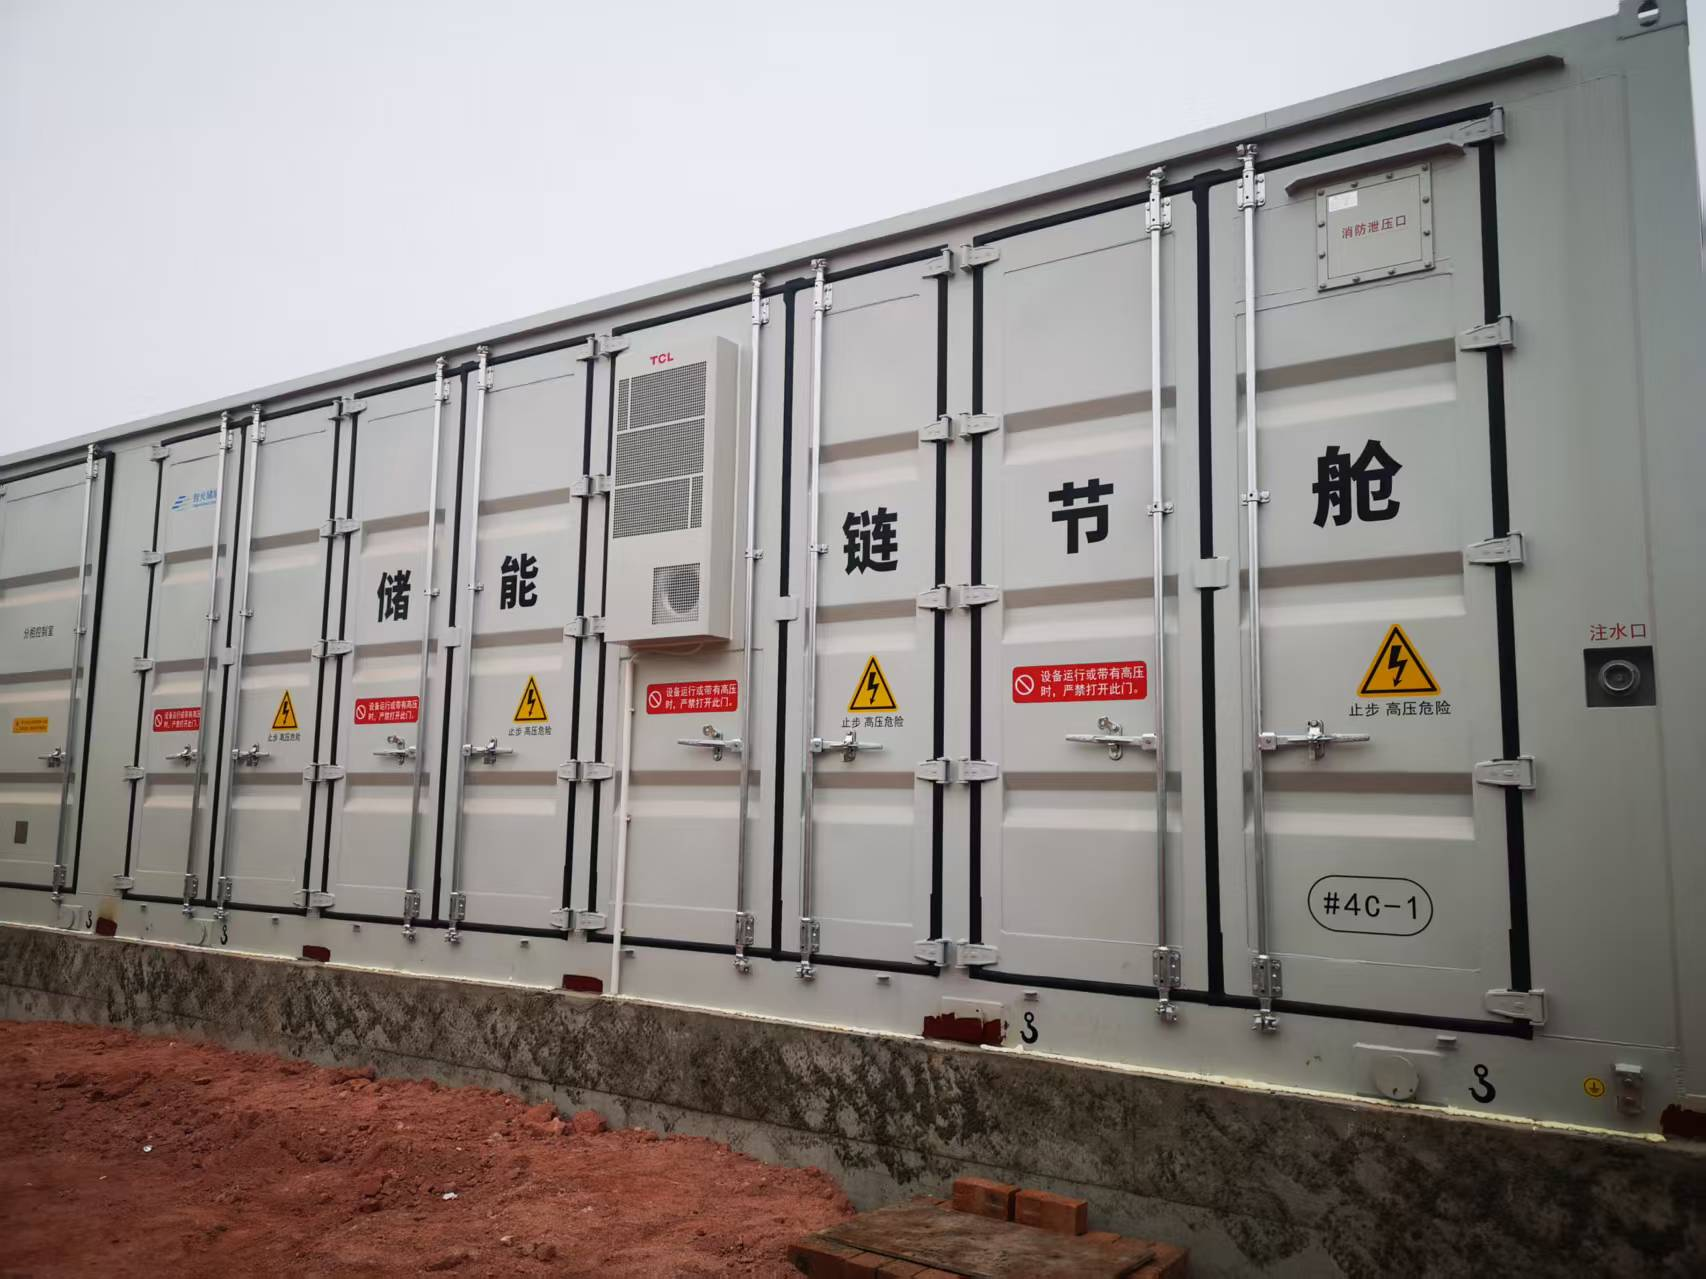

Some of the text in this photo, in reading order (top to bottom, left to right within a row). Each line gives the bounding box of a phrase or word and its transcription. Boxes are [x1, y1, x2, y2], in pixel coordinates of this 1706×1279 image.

[1342, 215, 1406, 239] 消防泄压口
[650, 352, 673, 365] TCL
[377, 439, 1402, 623] 储 能 链 节 舱
[1590, 622, 1646, 641] 注水口
[1040, 665, 1144, 683] 设备运行或带有高压
[666, 684, 736, 697] 设备运行或带有高压
[1349, 700, 1452, 717] 止步 高压危险
[841, 715, 904, 728] 止步 高压危险
[1323, 891, 1417, 920] #4C-1
